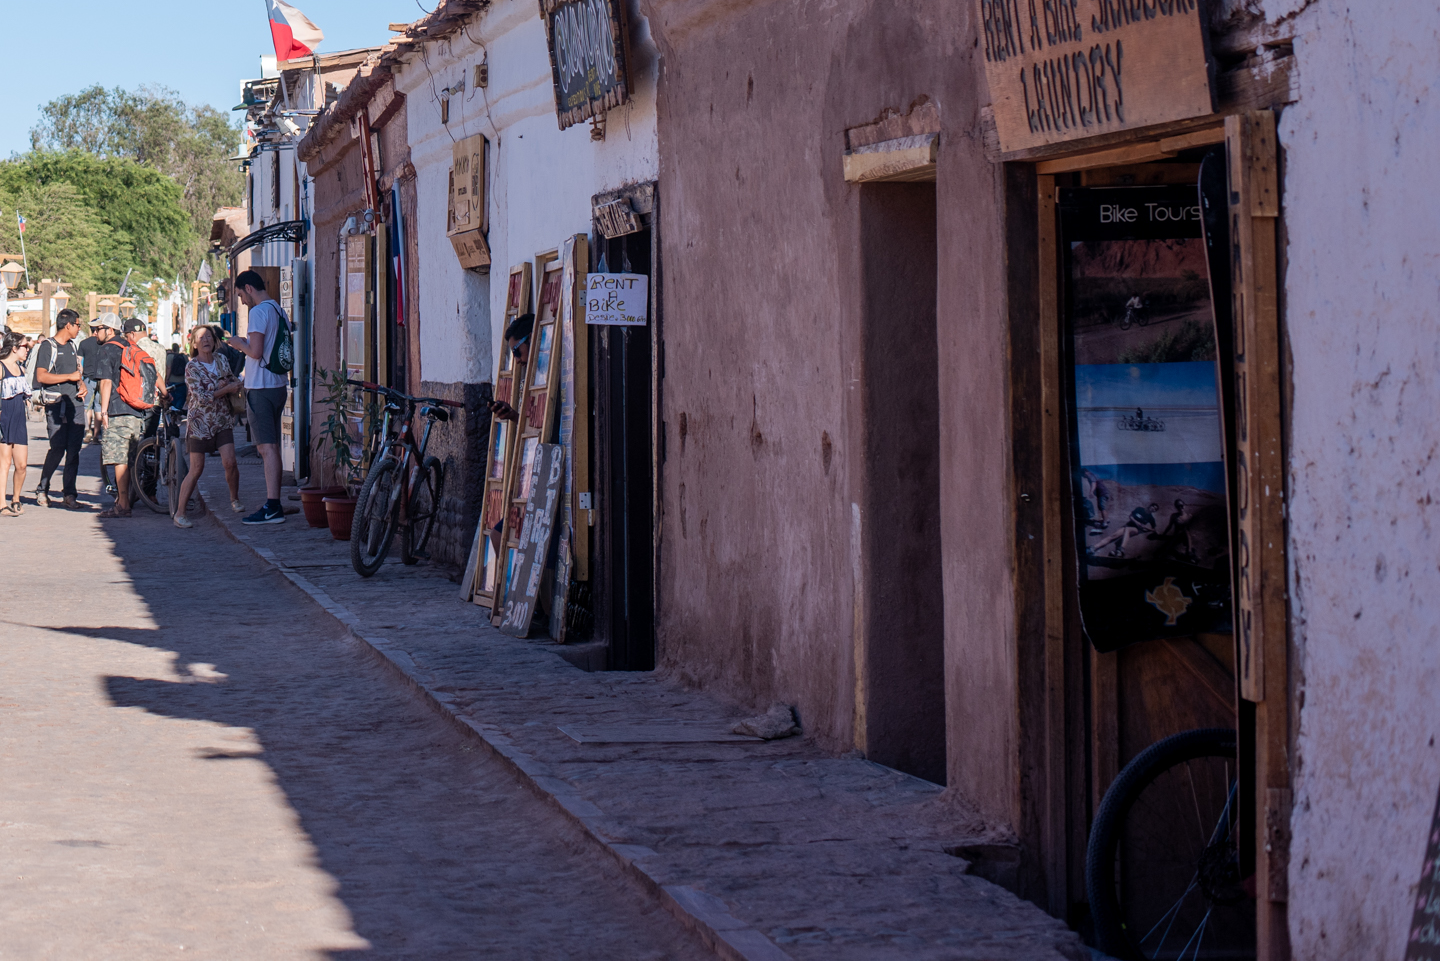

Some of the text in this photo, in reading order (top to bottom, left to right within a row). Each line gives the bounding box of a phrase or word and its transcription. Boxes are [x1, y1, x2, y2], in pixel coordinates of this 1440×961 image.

[1020, 39, 1125, 134] LAUNDRY
[1100, 202, 1203, 223] Bike Tours
[608, 290, 618, 302] A
